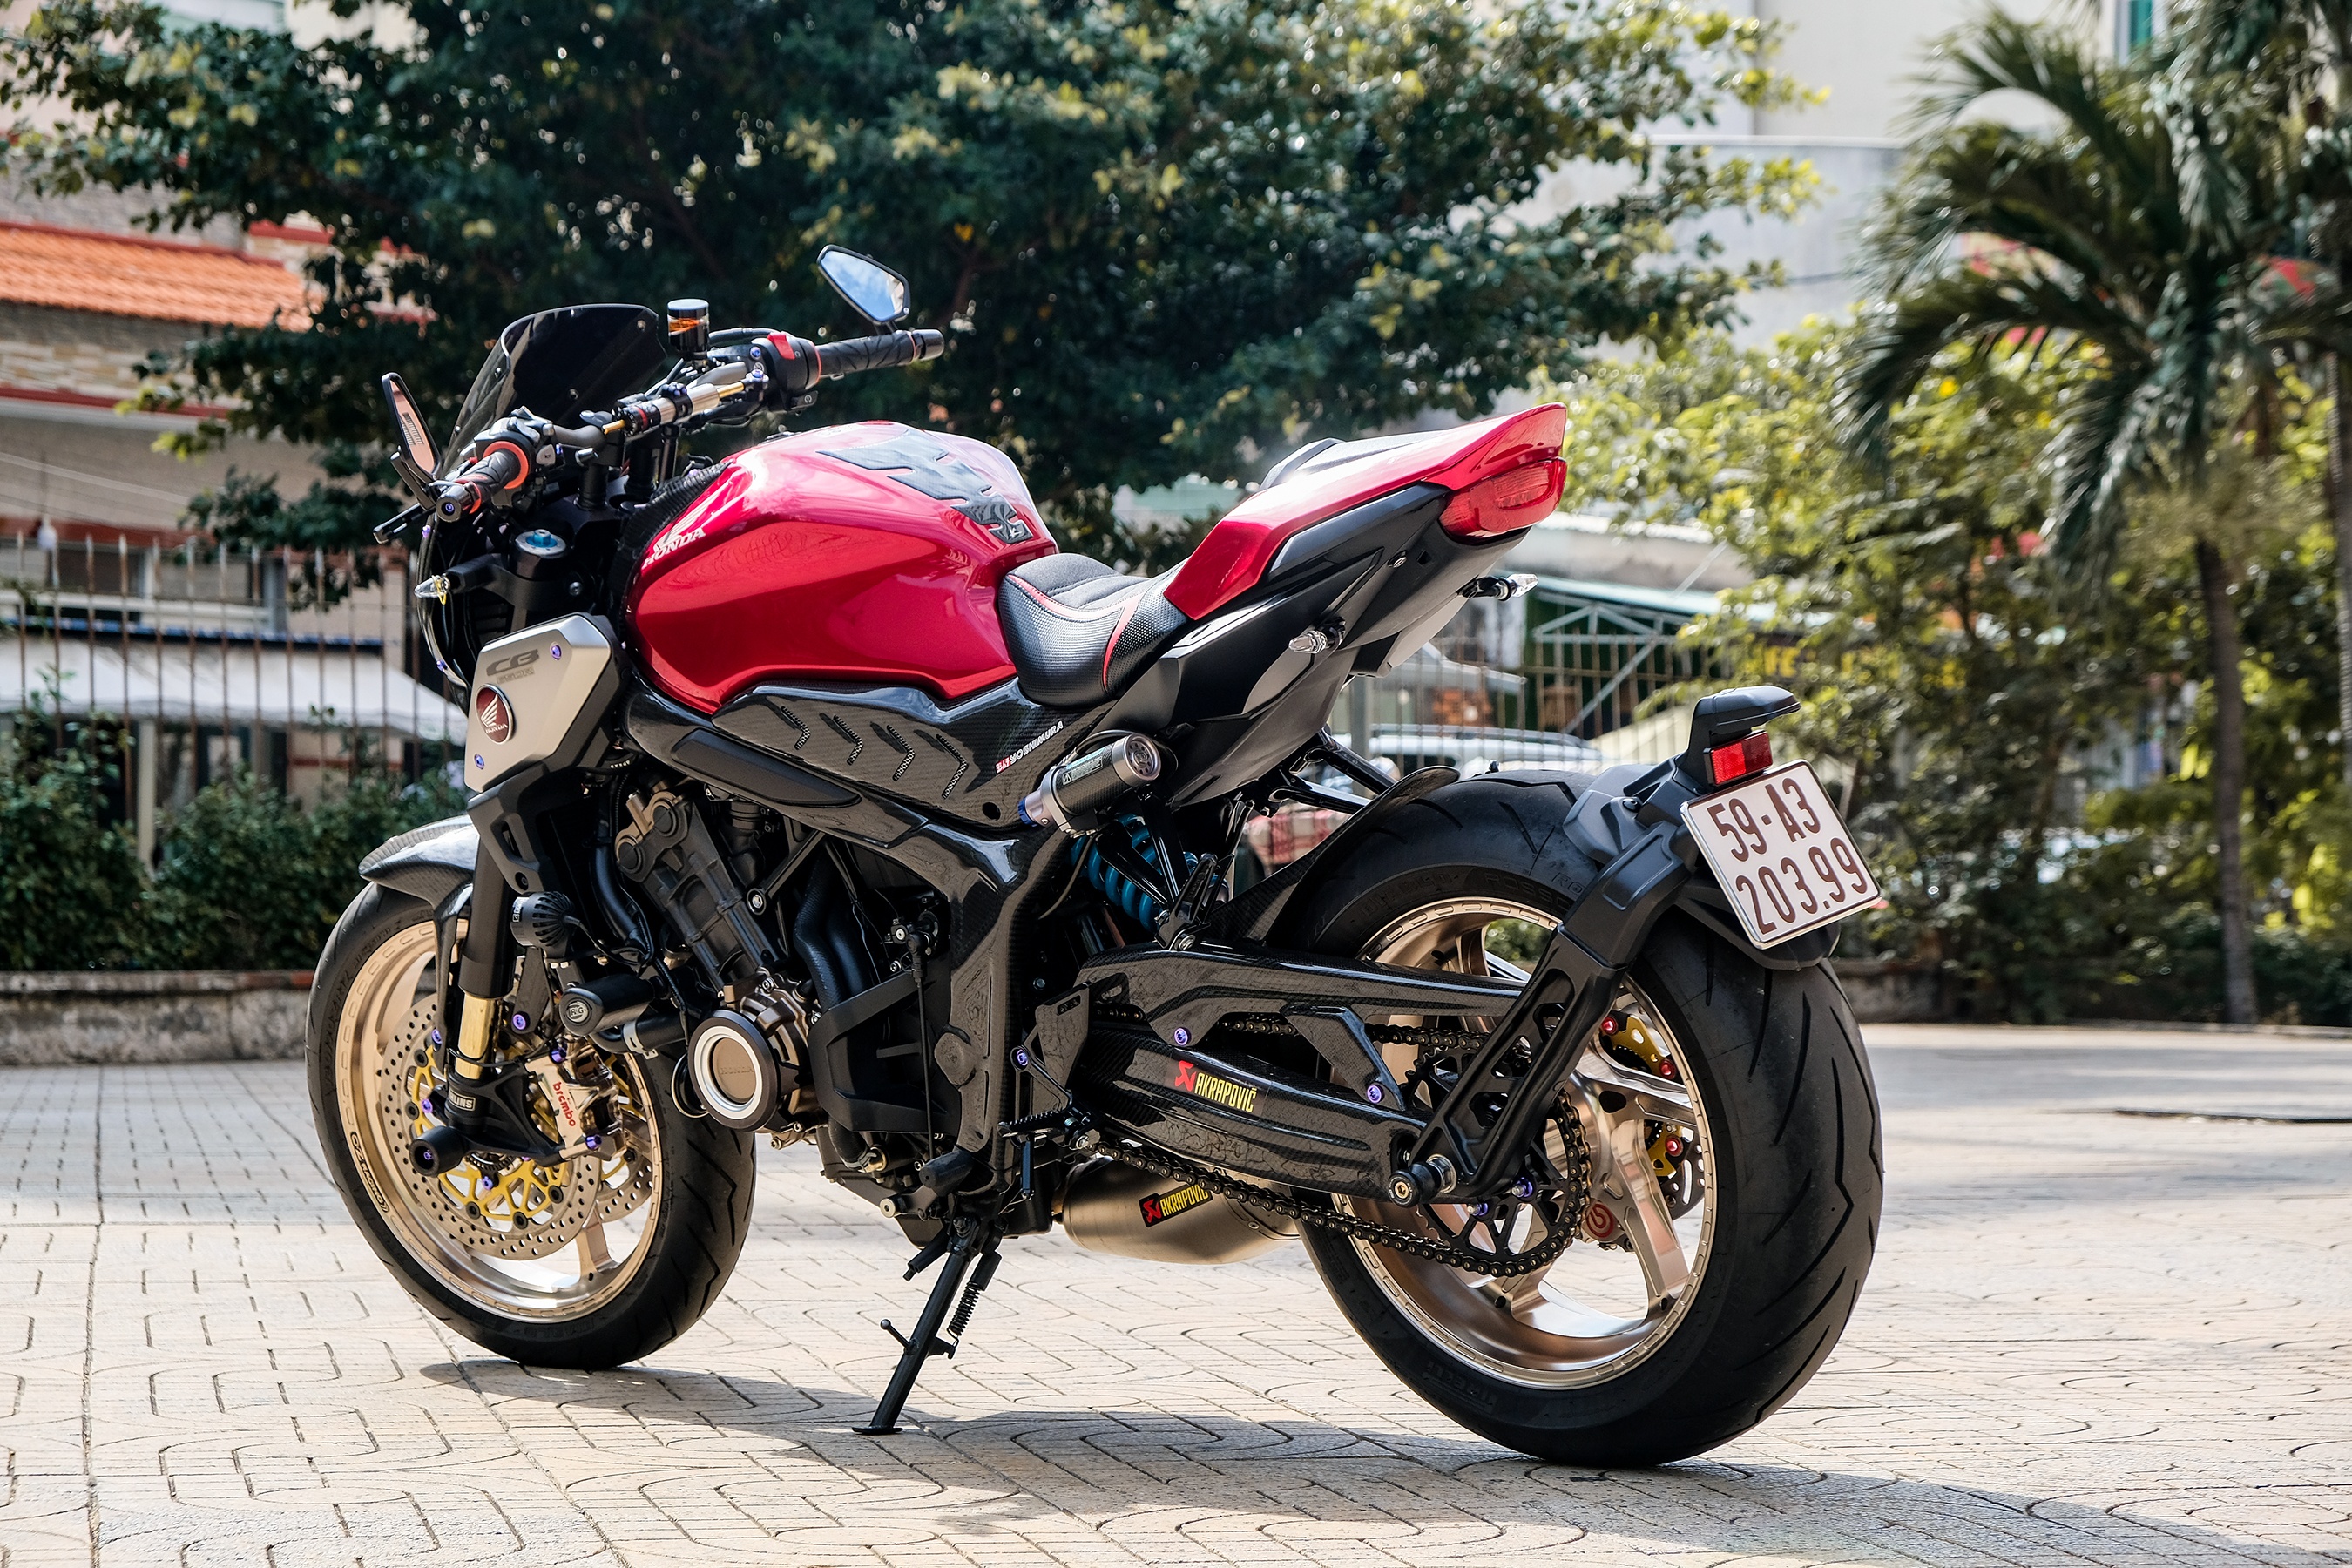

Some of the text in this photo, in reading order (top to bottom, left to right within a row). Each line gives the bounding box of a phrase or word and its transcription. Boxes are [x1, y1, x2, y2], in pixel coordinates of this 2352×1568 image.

[641, 527, 706, 570] HONDA
[486, 649, 539, 676] CB
[485, 723, 509, 733] HONDA
[1010, 720, 1064, 765] YOSHIMURA
[1735, 837, 1868, 935] 203.99
[720, 1066, 755, 1075] HONDA
[448, 1090, 473, 1109] HLINS
[552, 1082, 576, 1127] brembo
[1194, 1072, 1257, 1113] AKRAPOVIČ
[361, 1161, 386, 1204] RACING
